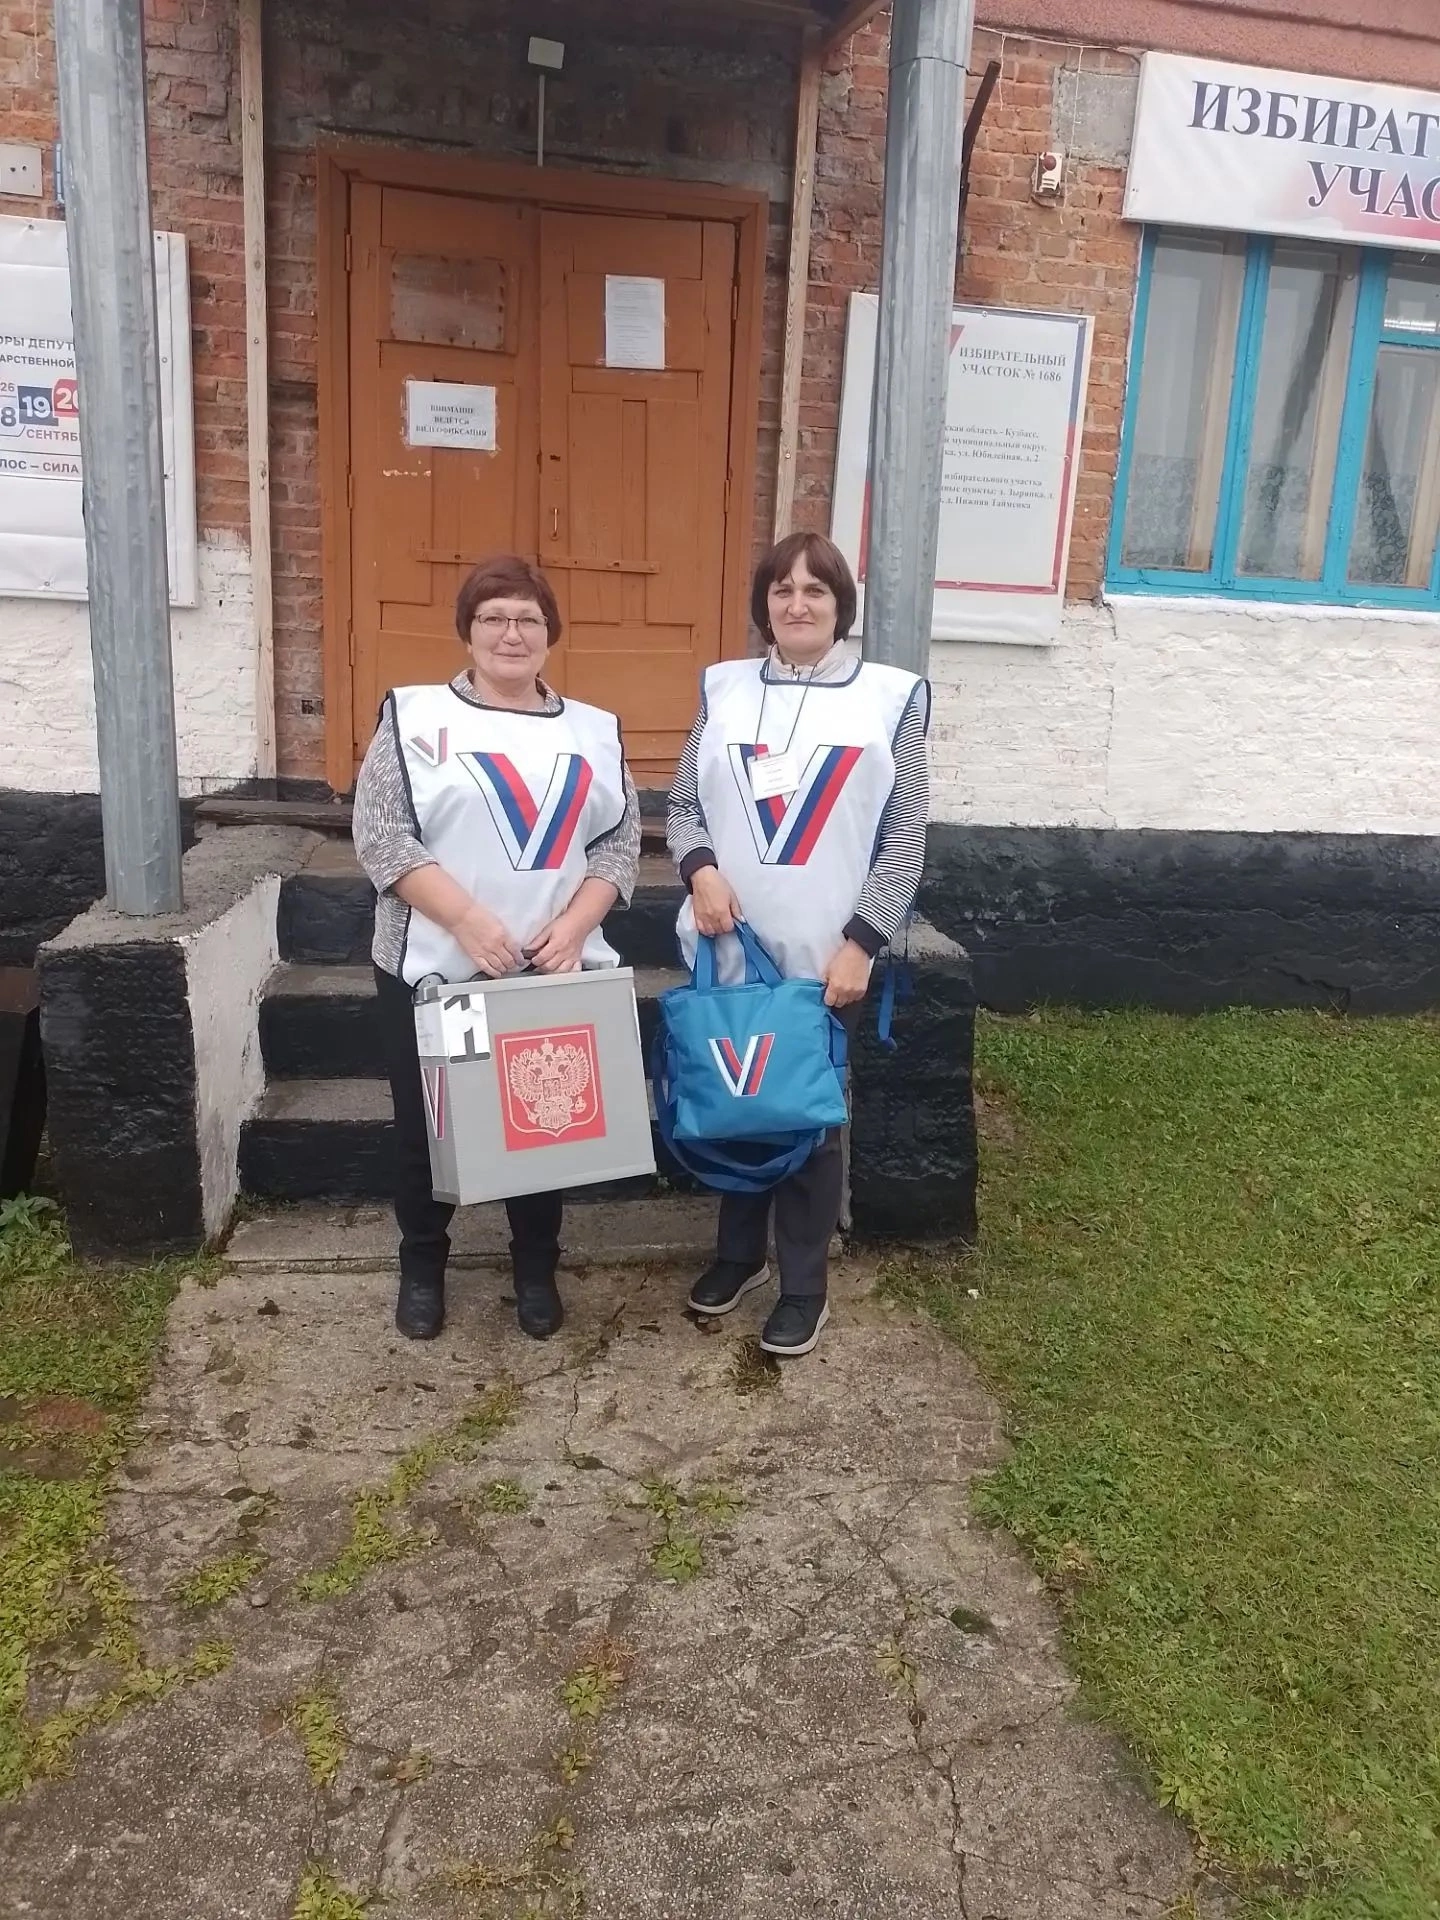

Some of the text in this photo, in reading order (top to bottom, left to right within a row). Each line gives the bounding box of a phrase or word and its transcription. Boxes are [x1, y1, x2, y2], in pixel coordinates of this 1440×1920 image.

[1187, 80, 1440, 159] ИЗБИРАТ
[28, 338, 75, 350] ДЕПУТ
[960, 346, 1066, 367] ИЗБИРАТЕЛЬНЫЙ
[962, 363, 1062, 382] УЧАСТОК № 1686
[22, 395, 50, 418] 19
[26, 429, 80, 442] СЕНТЯБ
[43, 462, 79, 474] СИЛА
